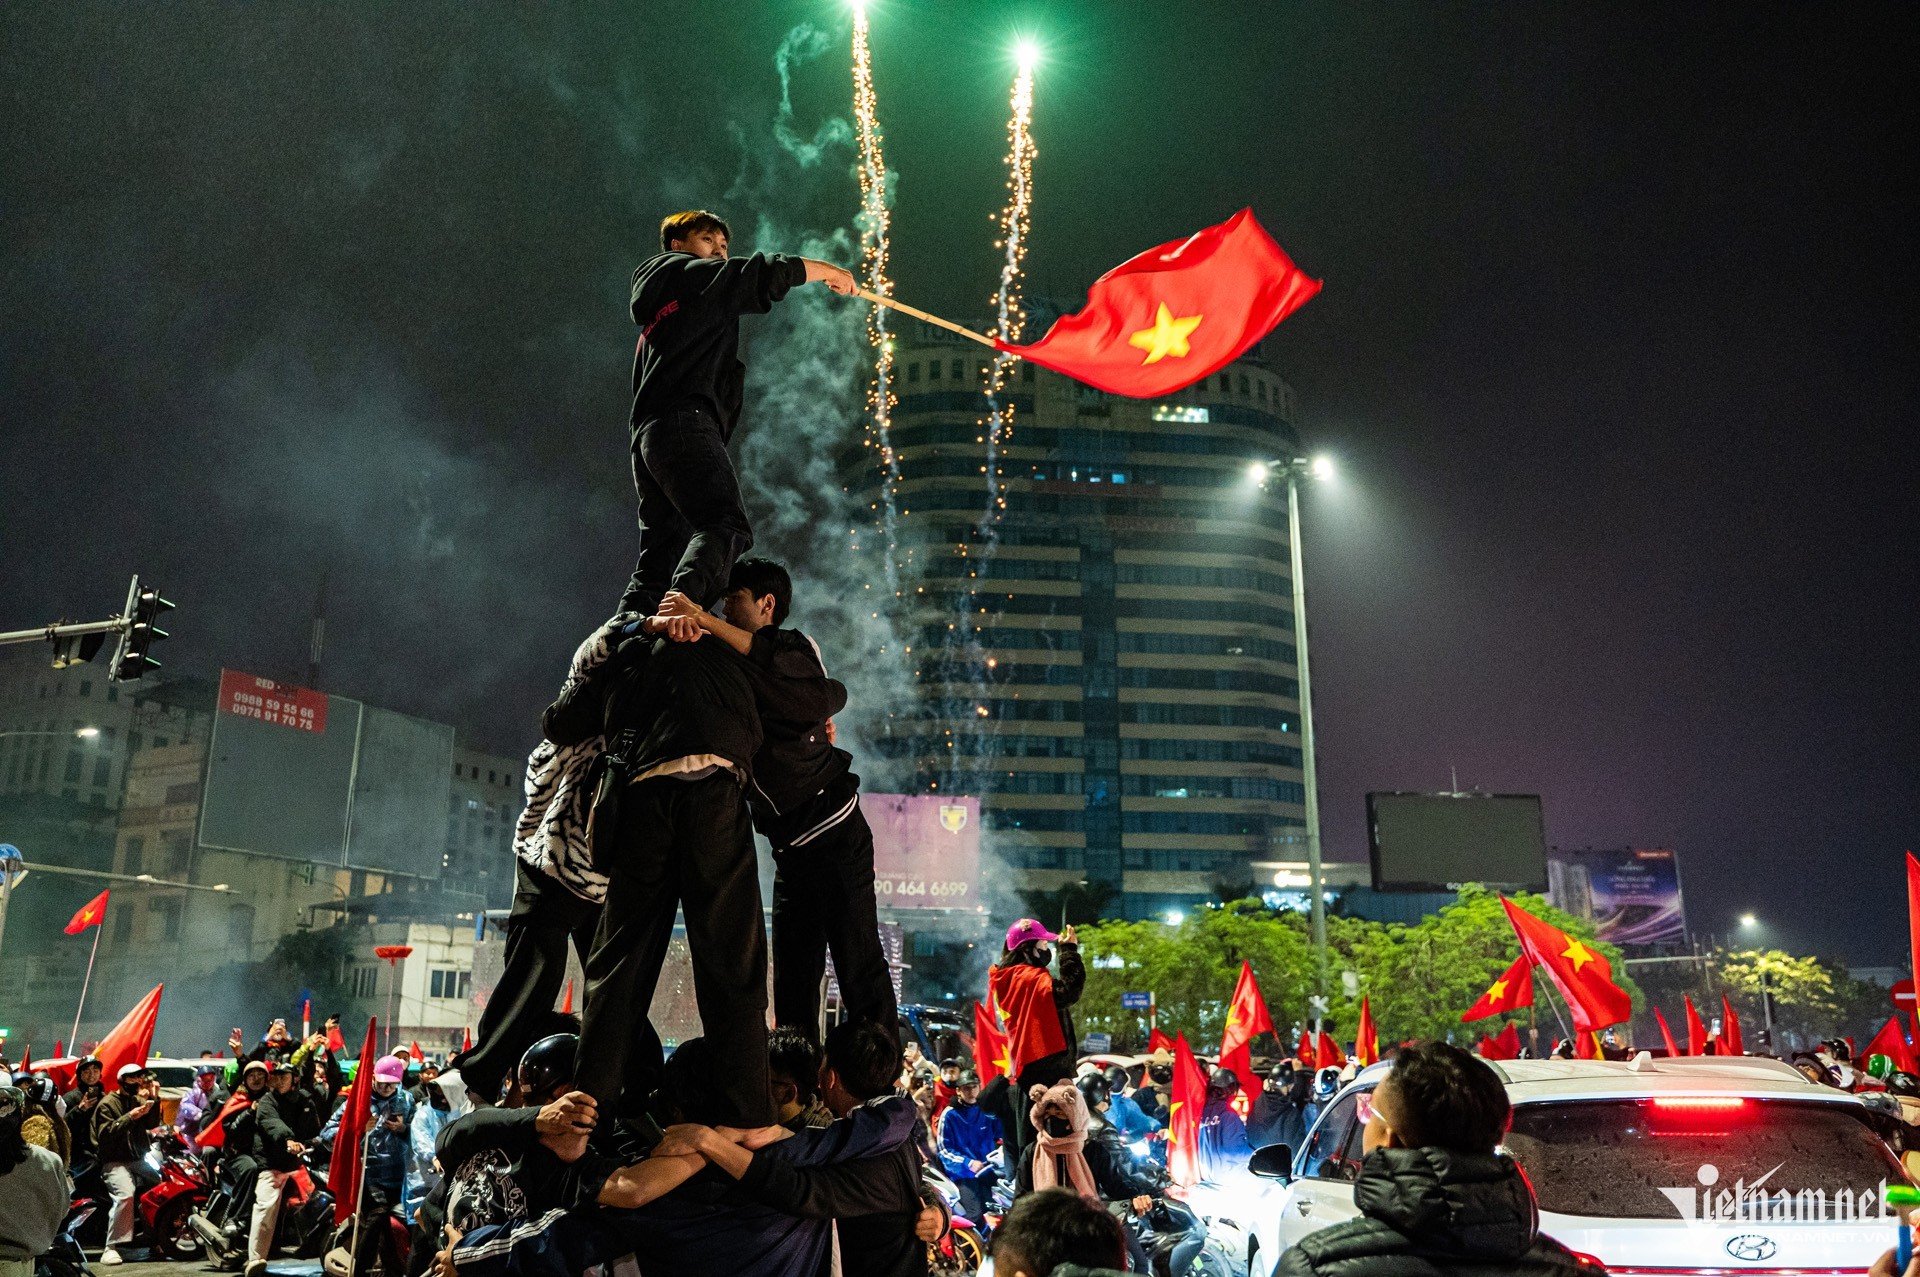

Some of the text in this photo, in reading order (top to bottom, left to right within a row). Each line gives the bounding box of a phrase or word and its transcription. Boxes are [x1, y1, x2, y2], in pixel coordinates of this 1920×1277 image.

[255, 677, 275, 690] RED
[234, 691, 314, 719] 0988 59 55 66
[232, 703, 313, 730] 0978 91 70 75
[896, 880, 926, 897] 464
[930, 881, 968, 897] 6699
